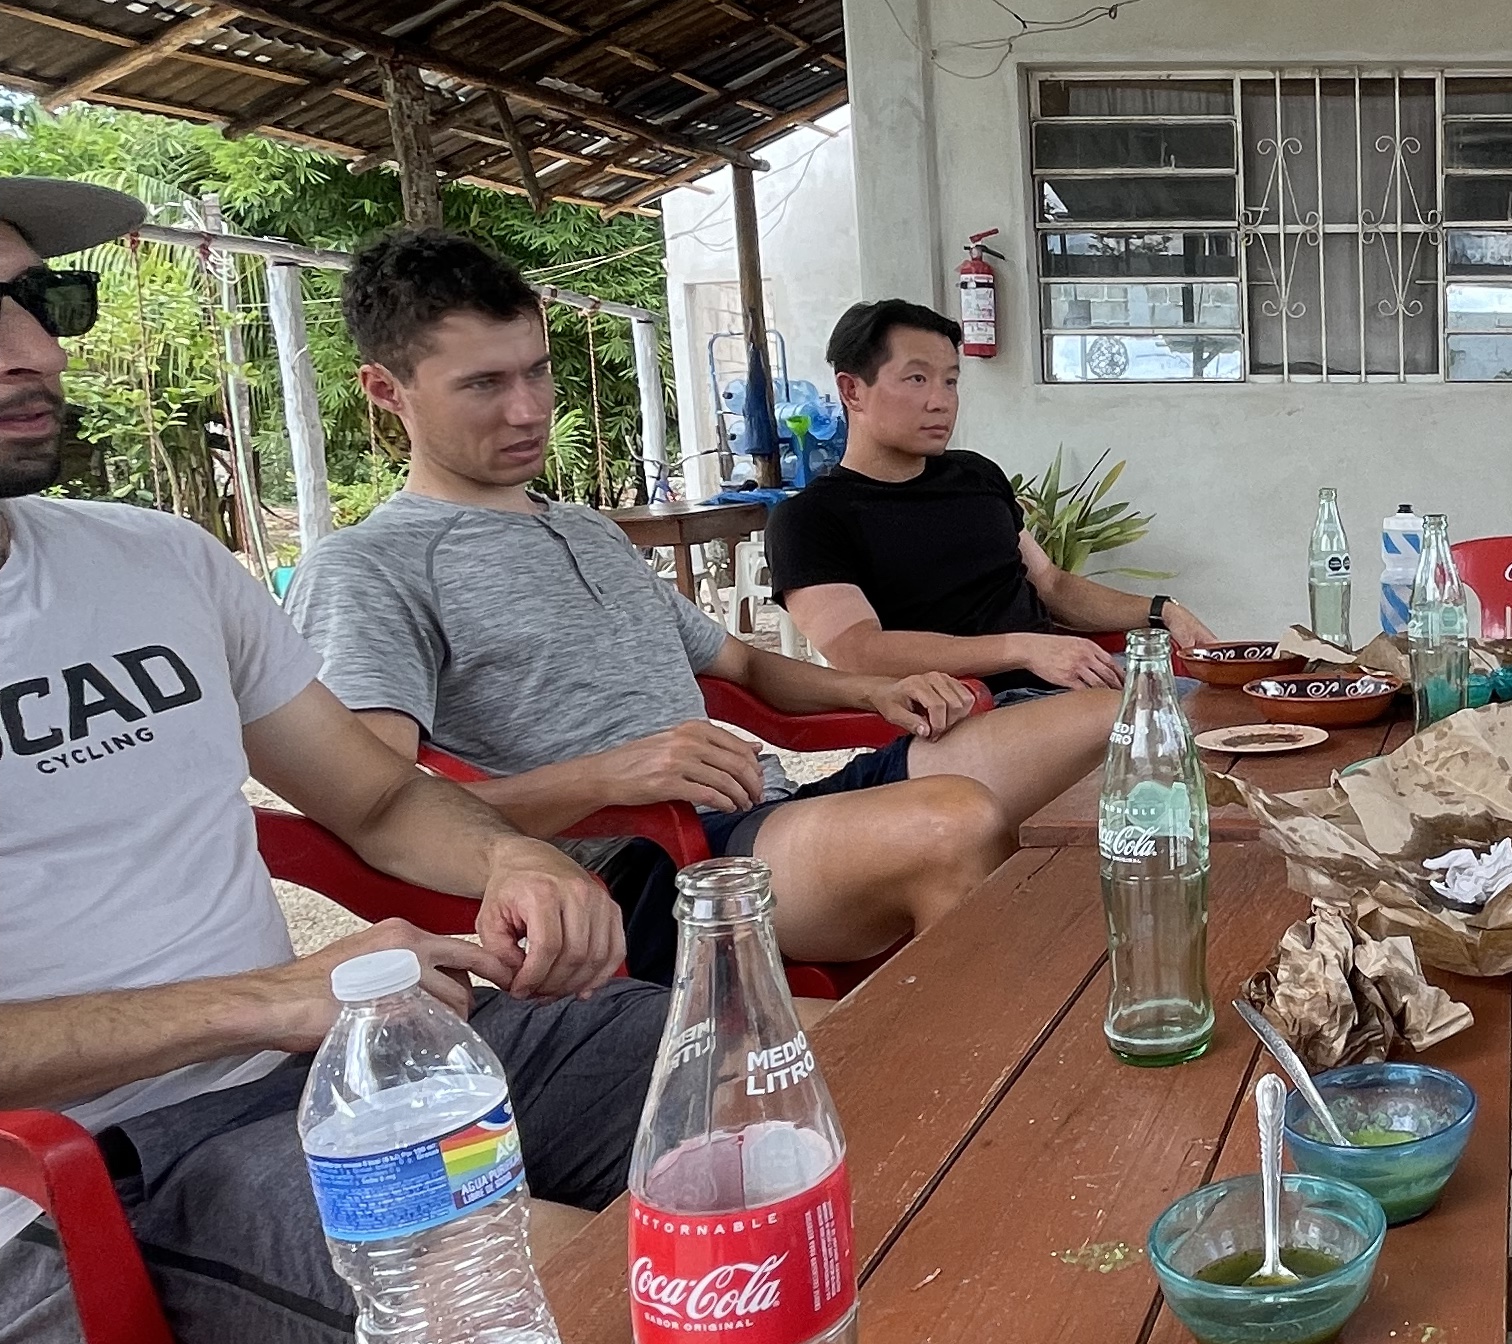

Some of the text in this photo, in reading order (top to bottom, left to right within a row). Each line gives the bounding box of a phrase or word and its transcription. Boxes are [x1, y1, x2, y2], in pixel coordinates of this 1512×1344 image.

[0, 645, 202, 757] CAD
[36, 727, 154, 774] CYCLING
[745, 1050, 816, 1096] LITRO
[746, 1029, 808, 1072] MEDIO
[633, 1208, 778, 1236] RETORNABLE
[631, 1250, 790, 1319] Coca-Cola
[644, 1312, 754, 1332] SABOR ORIGINAL
